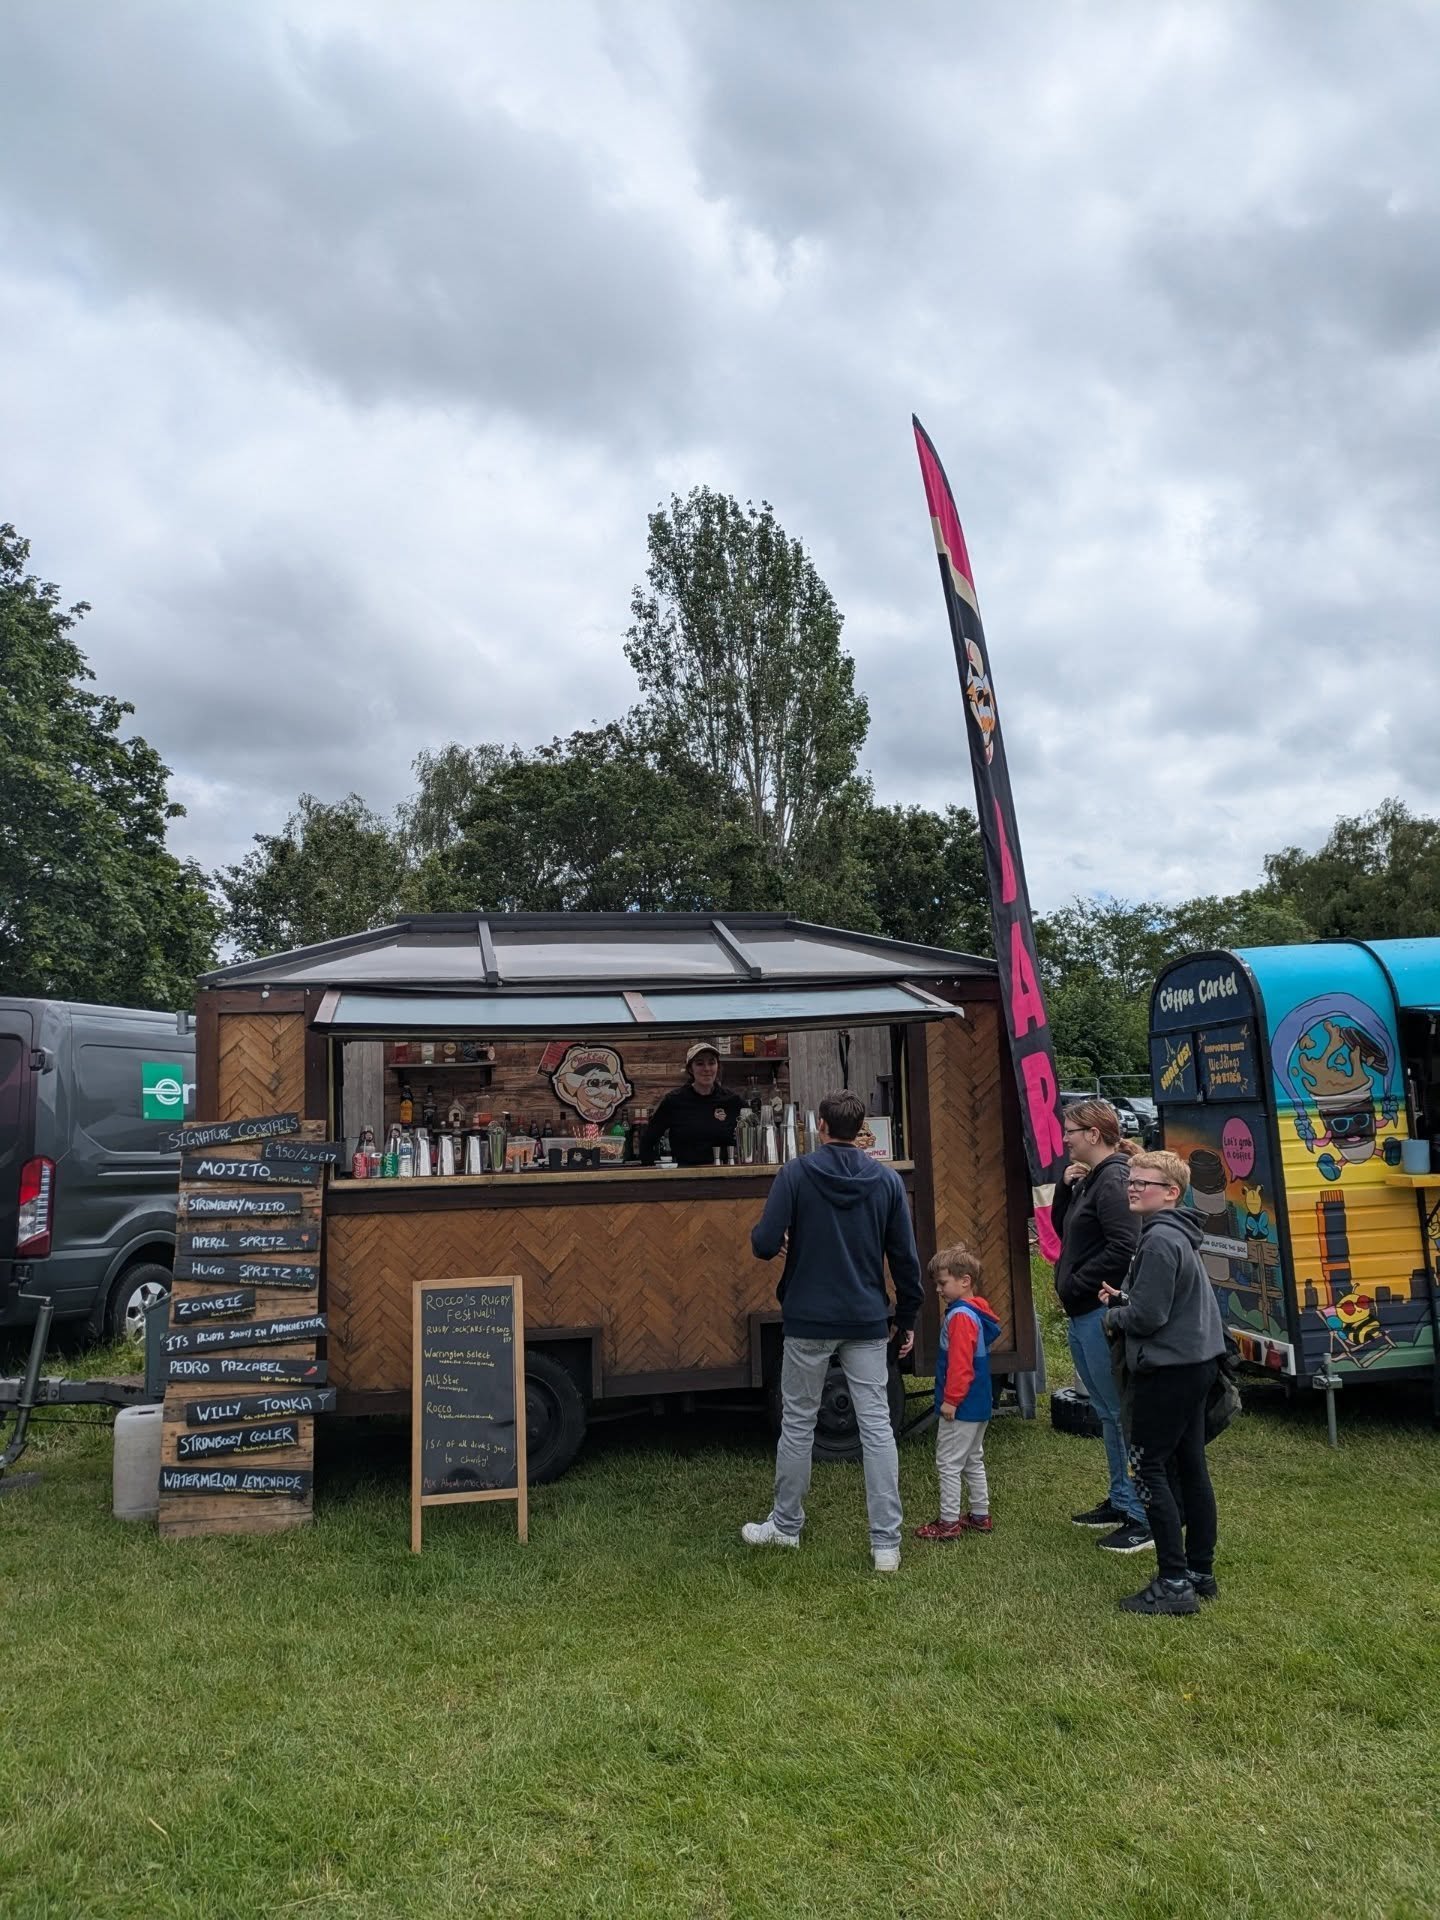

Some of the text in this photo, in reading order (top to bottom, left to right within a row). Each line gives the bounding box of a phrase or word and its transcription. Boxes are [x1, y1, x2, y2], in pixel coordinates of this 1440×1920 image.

[1198, 971, 1239, 1004] Cartel
[1160, 1041, 1192, 1091] HIRE US!
[1208, 1053, 1240, 1072] Weddings
[168, 1126, 232, 1149] SIGNATURE
[238, 1117, 299, 1138] COCKTAILS
[1223, 1136, 1253, 1150] Let's grab
[197, 1161, 271, 1177] MOJITO
[188, 1197, 245, 1214] STRAWBERRY
[244, 1200, 285, 1212] MOJITO
[192, 1236, 287, 1249] APEROL SPRITZ
[192, 1262, 291, 1280] HUGO SPRITZ
[178, 1294, 244, 1315] ZOMBIE
[426, 1293, 511, 1311] ROCCO'S RUGBY
[166, 1335, 189, 1352] ITS
[197, 1332, 224, 1345] ALWAYS
[229, 1329, 252, 1340] SUNNY
[255, 1328, 267, 1337] IN
[270, 1317, 325, 1334] MANCHESTER
[426, 1325, 449, 1336] RUGBY
[424, 1347, 492, 1361] Warrington Select
[169, 1360, 285, 1375] PEDRO PAZCABEL
[424, 1373, 460, 1387] All Star
[197, 1402, 242, 1421] WILLY
[257, 1397, 313, 1412] TONKA
[179, 1432, 243, 1454] STRAWBOOZY
[250, 1427, 295, 1444] COOLER
[470, 1441, 491, 1451] drinks
[163, 1472, 302, 1490] WATERMELON LEMONADE
